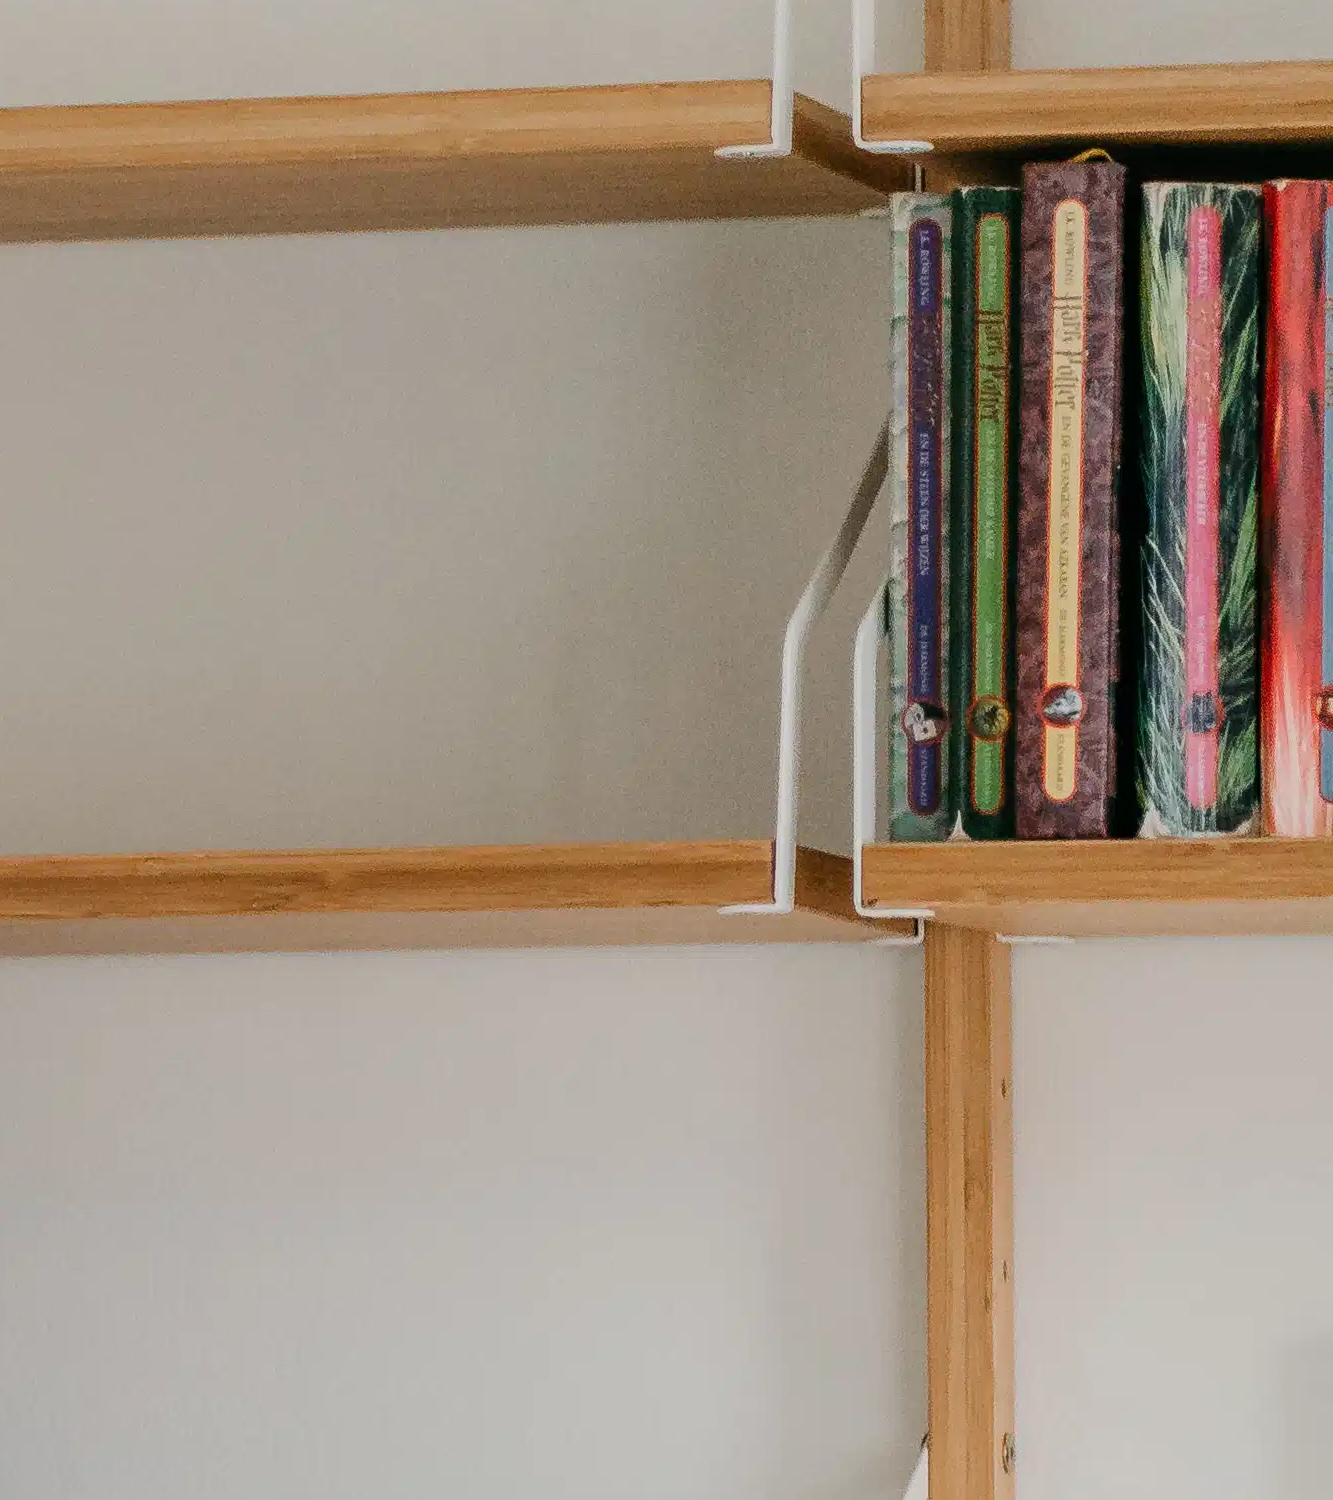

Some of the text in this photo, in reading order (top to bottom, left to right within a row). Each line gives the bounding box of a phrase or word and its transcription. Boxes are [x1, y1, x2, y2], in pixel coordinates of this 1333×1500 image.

[1064, 230, 1075, 286] ROWLING
[977, 361, 1010, 423] Potter
[1052, 349, 1090, 410] Potter
[1058, 415, 1072, 599] EN DE GEVANGENE VAN AZKABAN
